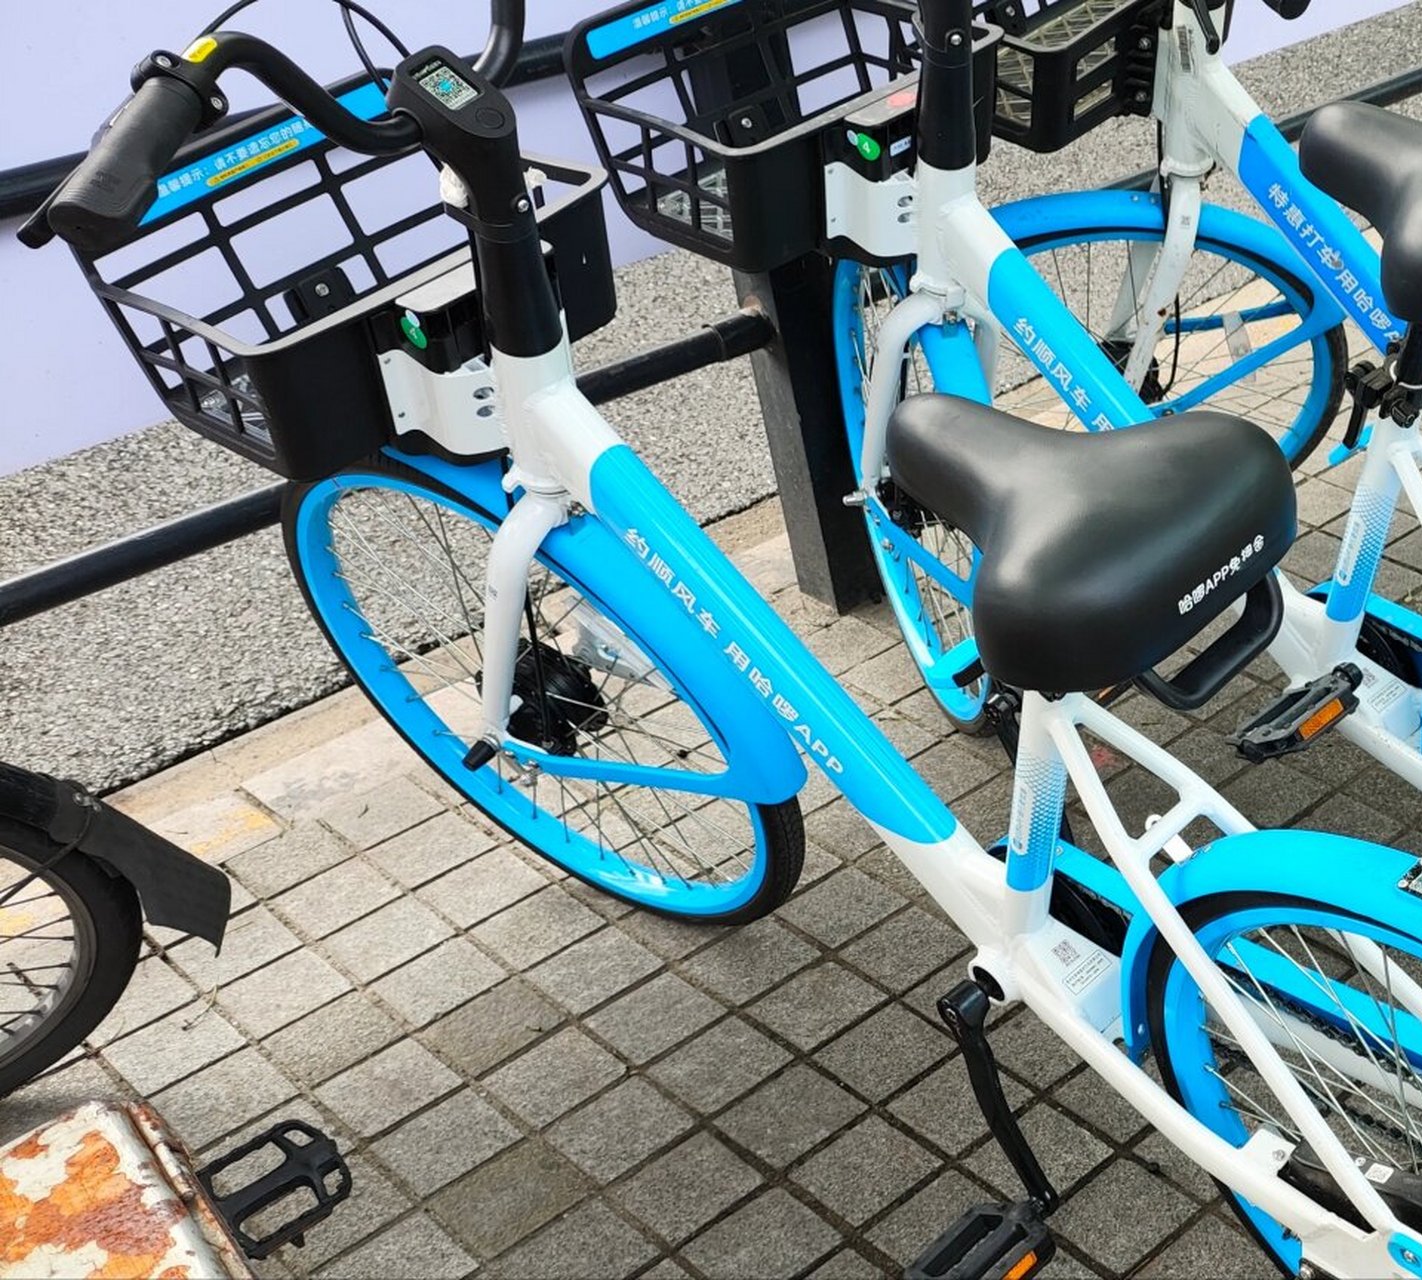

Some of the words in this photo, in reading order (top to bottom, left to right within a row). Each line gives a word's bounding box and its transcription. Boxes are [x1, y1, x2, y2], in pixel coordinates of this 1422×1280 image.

[1013, 318, 1092, 412] 约顺风车
[1178, 534, 1264, 615] 哈啰APP免押金
[623, 528, 721, 639] 约顺风车
[724, 641, 844, 774] 用哈啰APP
